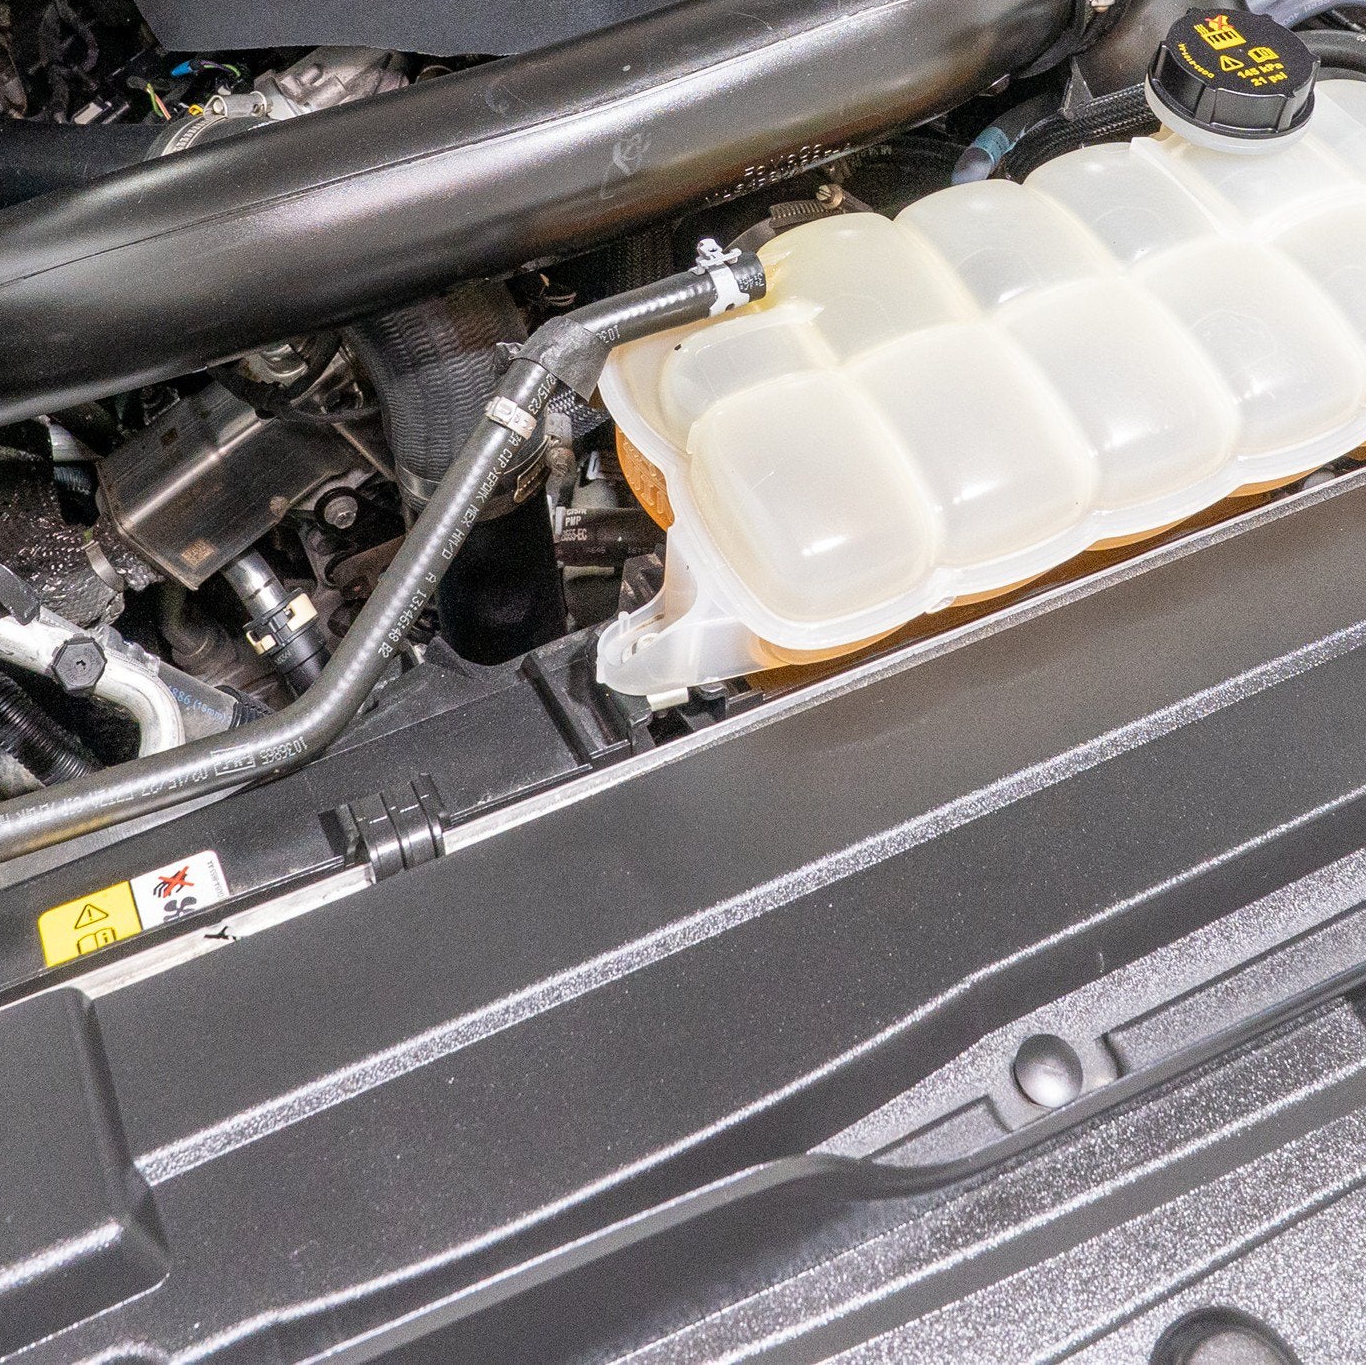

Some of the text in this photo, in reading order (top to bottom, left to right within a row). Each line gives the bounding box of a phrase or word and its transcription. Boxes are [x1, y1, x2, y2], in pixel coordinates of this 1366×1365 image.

[1251, 75, 1268, 87] 21
[459, 502, 480, 528] MEX
[385, 585, 428, 645] 13:46:48
[257, 734, 309, 765] 1036865
